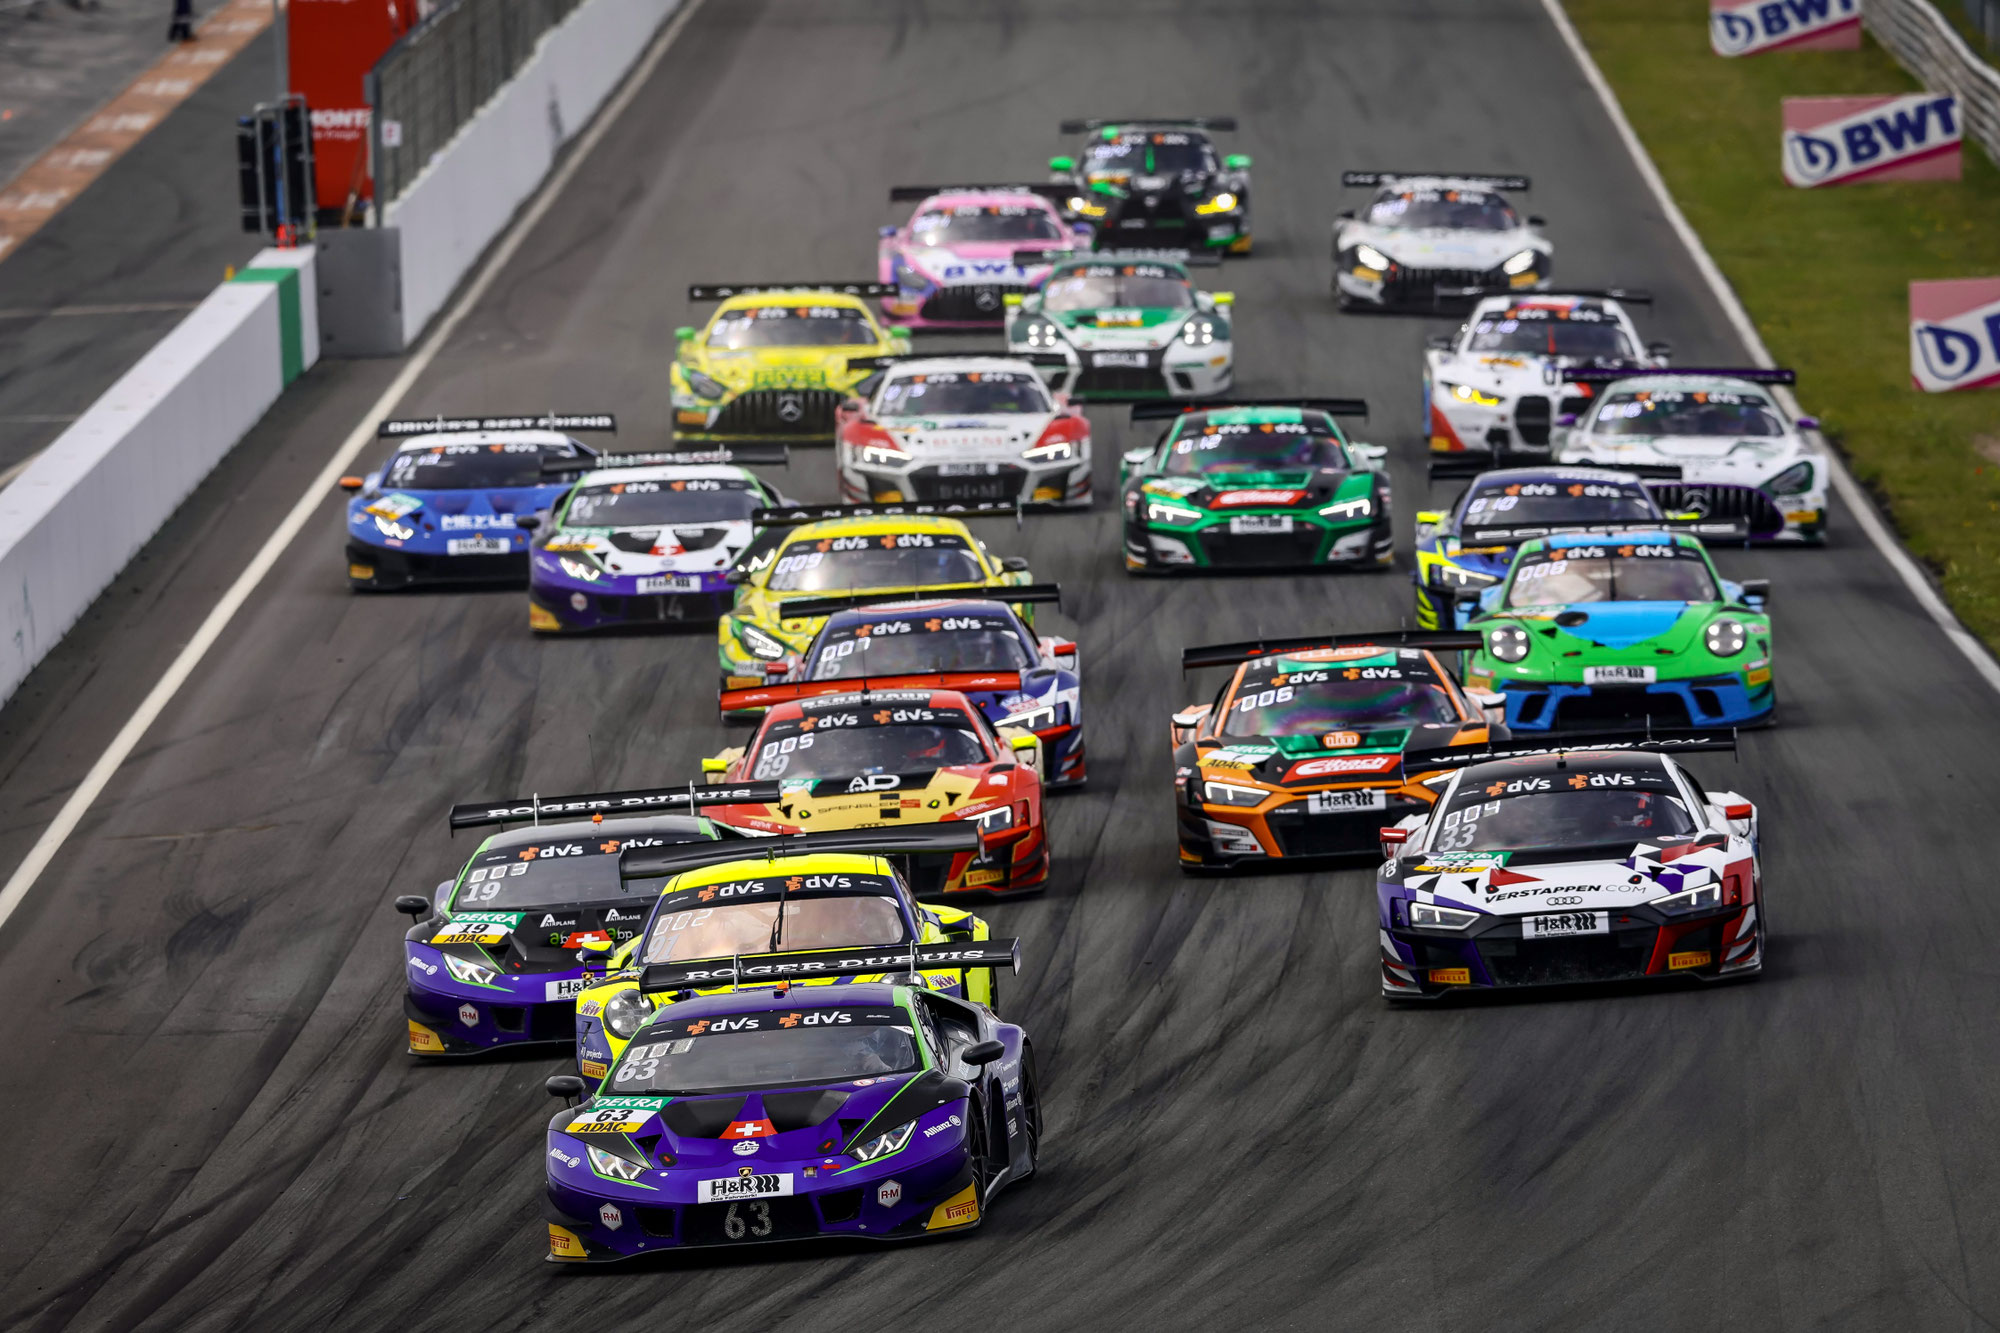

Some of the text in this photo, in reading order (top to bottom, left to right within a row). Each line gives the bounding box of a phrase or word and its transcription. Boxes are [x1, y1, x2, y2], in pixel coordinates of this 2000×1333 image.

[1842, 98, 1956, 164] BWT
[1520, 483, 1557, 496] dvs
[1583, 484, 1620, 498] dvs
[440, 513, 516, 531] MEYLE
[832, 536, 869, 550] dvs
[897, 533, 934, 548] dvs
[1566, 546, 1605, 559] dvs
[1635, 545, 1675, 558] dvs
[873, 621, 911, 634] dvs
[943, 617, 982, 631] dvs
[1288, 671, 1329, 684] dvs
[1361, 667, 1403, 680] dvs
[818, 714, 859, 728] dvs
[893, 709, 935, 722] dvs
[754, 754, 790, 780] 69
[1506, 778, 1551, 792] dvs
[1589, 773, 1635, 787] dvs
[486, 788, 752, 818] ROGER DUBUIS
[1320, 792, 1355, 806] H&R
[1437, 823, 1478, 852] 33
[540, 844, 584, 858] dvs
[720, 881, 765, 897] dvs
[806, 874, 852, 889] dvs
[463, 881, 502, 903] 19
[1484, 884, 1647, 904] VERSTAPPEN.COM
[454, 913, 517, 926] DEKRA
[1534, 916, 1572, 932] H&R
[458, 923, 491, 934] 19
[443, 934, 489, 943] ADAC
[643, 935, 681, 963] 91
[684, 949, 985, 980] ROGER DUBUIS
[1672, 952, 1710, 968] PIRELLI
[1430, 969, 1469, 984] PIRELLI
[710, 1017, 759, 1032] dvs
[803, 1011, 852, 1026] dvs
[615, 1058, 660, 1082] 63
[594, 1097, 665, 1109] DEKRA
[595, 1109, 634, 1122] 63
[577, 1122, 628, 1132] ADAC
[923, 1121, 953, 1139] Allianz
[549, 1147, 572, 1163] Allianz
[711, 1178, 754, 1197] H&R
[946, 1200, 977, 1219] PIRELLI
[724, 1199, 773, 1239] 63
